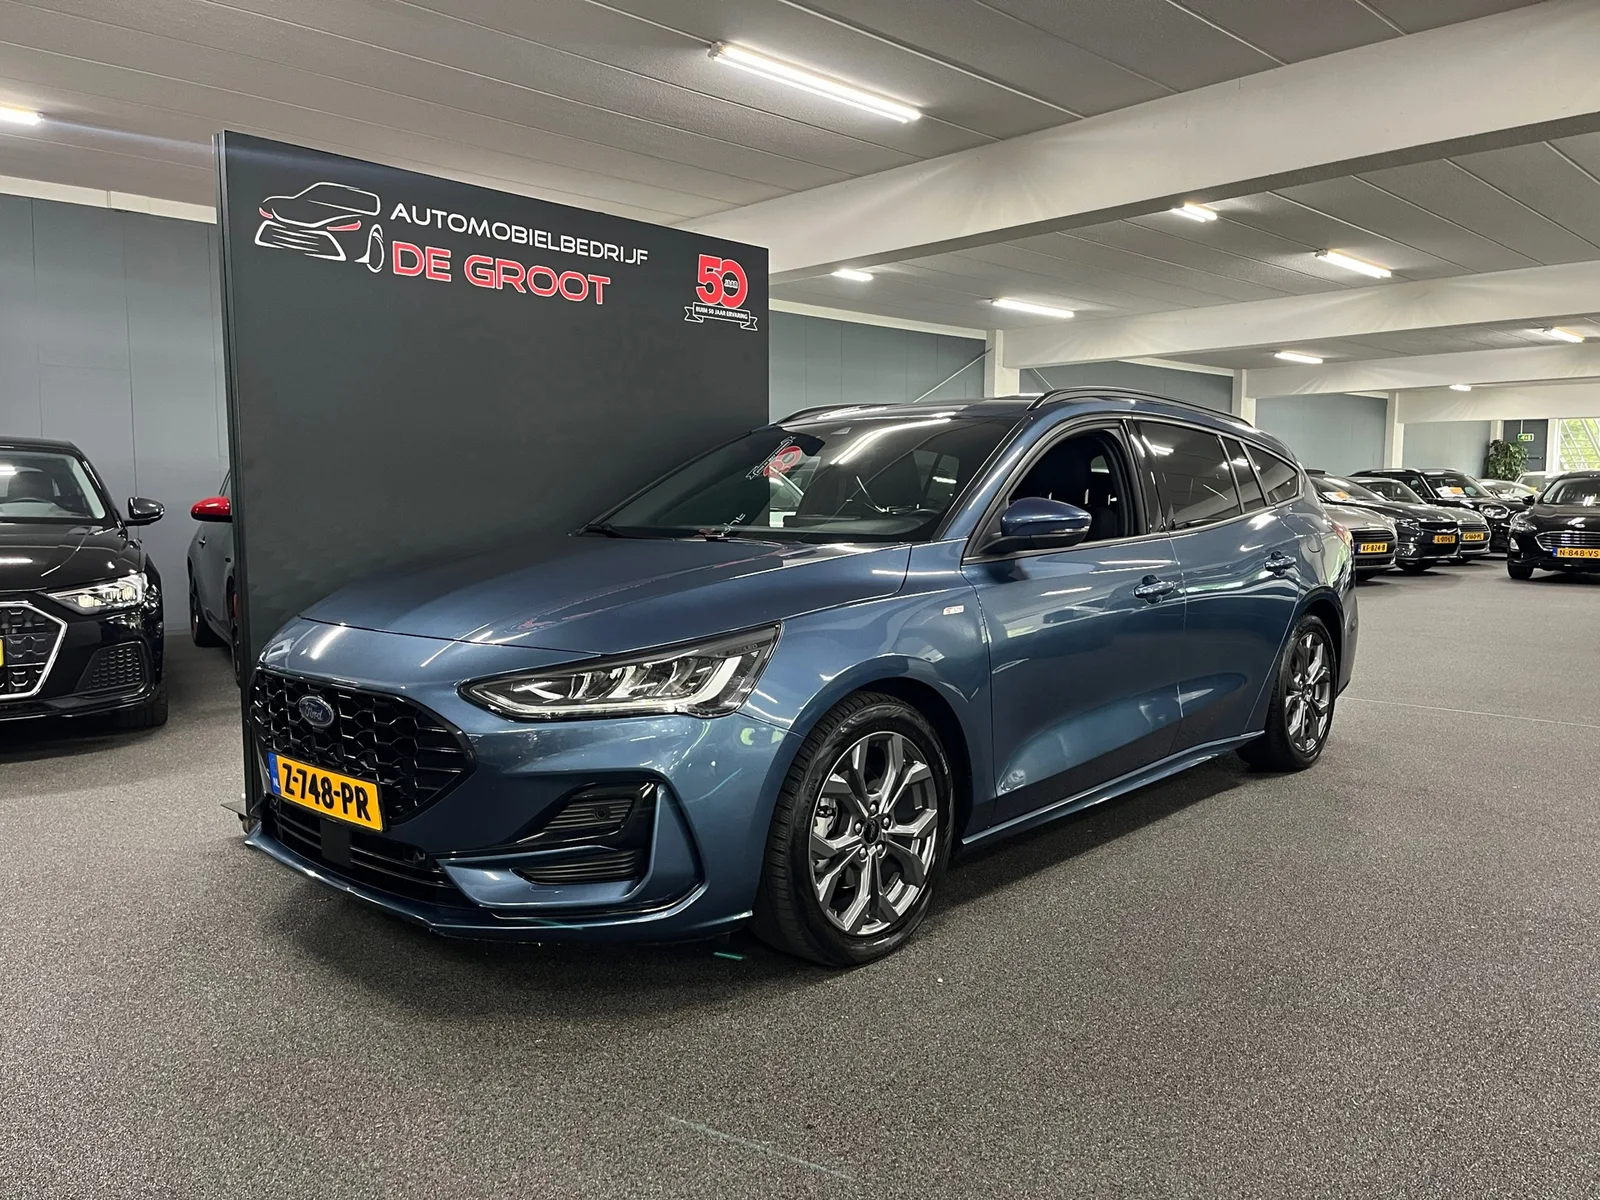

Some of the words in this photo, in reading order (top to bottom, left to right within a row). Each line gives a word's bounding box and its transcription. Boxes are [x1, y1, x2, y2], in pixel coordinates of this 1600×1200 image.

[389, 202, 649, 266] AUTOMOBIELBEDRIJF
[392, 240, 452, 282] DE
[464, 254, 611, 305] GROOT
[696, 254, 748, 309] 50
[1559, 549, 1599, 557] N-848-VS
[282, 763, 371, 822] Z-748-PR
